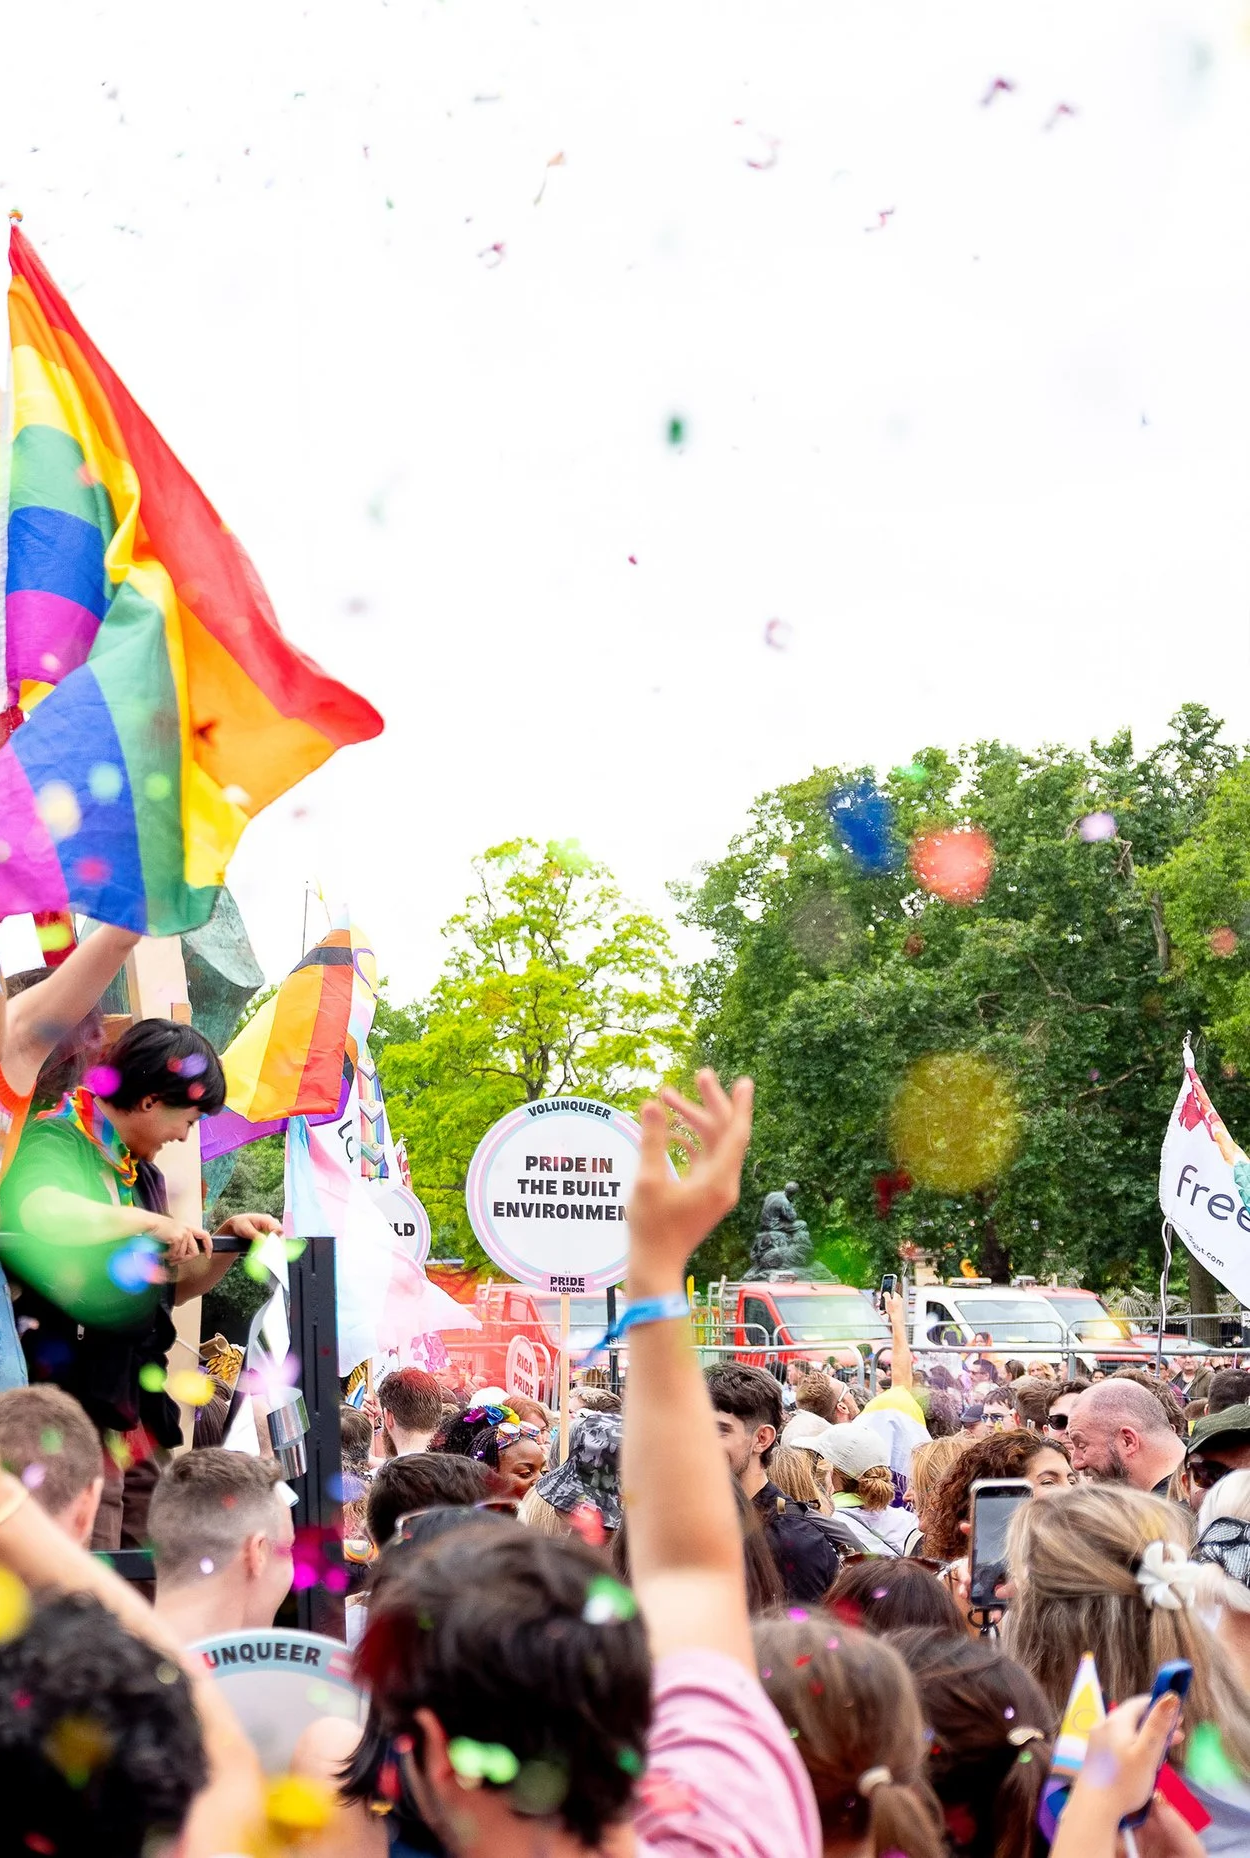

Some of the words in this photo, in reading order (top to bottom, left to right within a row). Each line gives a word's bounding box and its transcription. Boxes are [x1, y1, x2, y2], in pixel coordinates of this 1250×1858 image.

[528, 1100, 612, 1120] VOLUNQUEER
[525, 1156, 587, 1173] PRIDE
[591, 1157, 613, 1173] IN
[517, 1179, 557, 1195] THE
[563, 1180, 621, 1197] BUILT
[493, 1202, 628, 1221] ENVIRONMEN
[390, 1223, 416, 1237] LD
[517, 1353, 533, 1376] RIGA
[514, 1372, 534, 1399] PRIDE
[202, 1642, 321, 1669] UNQUEER
